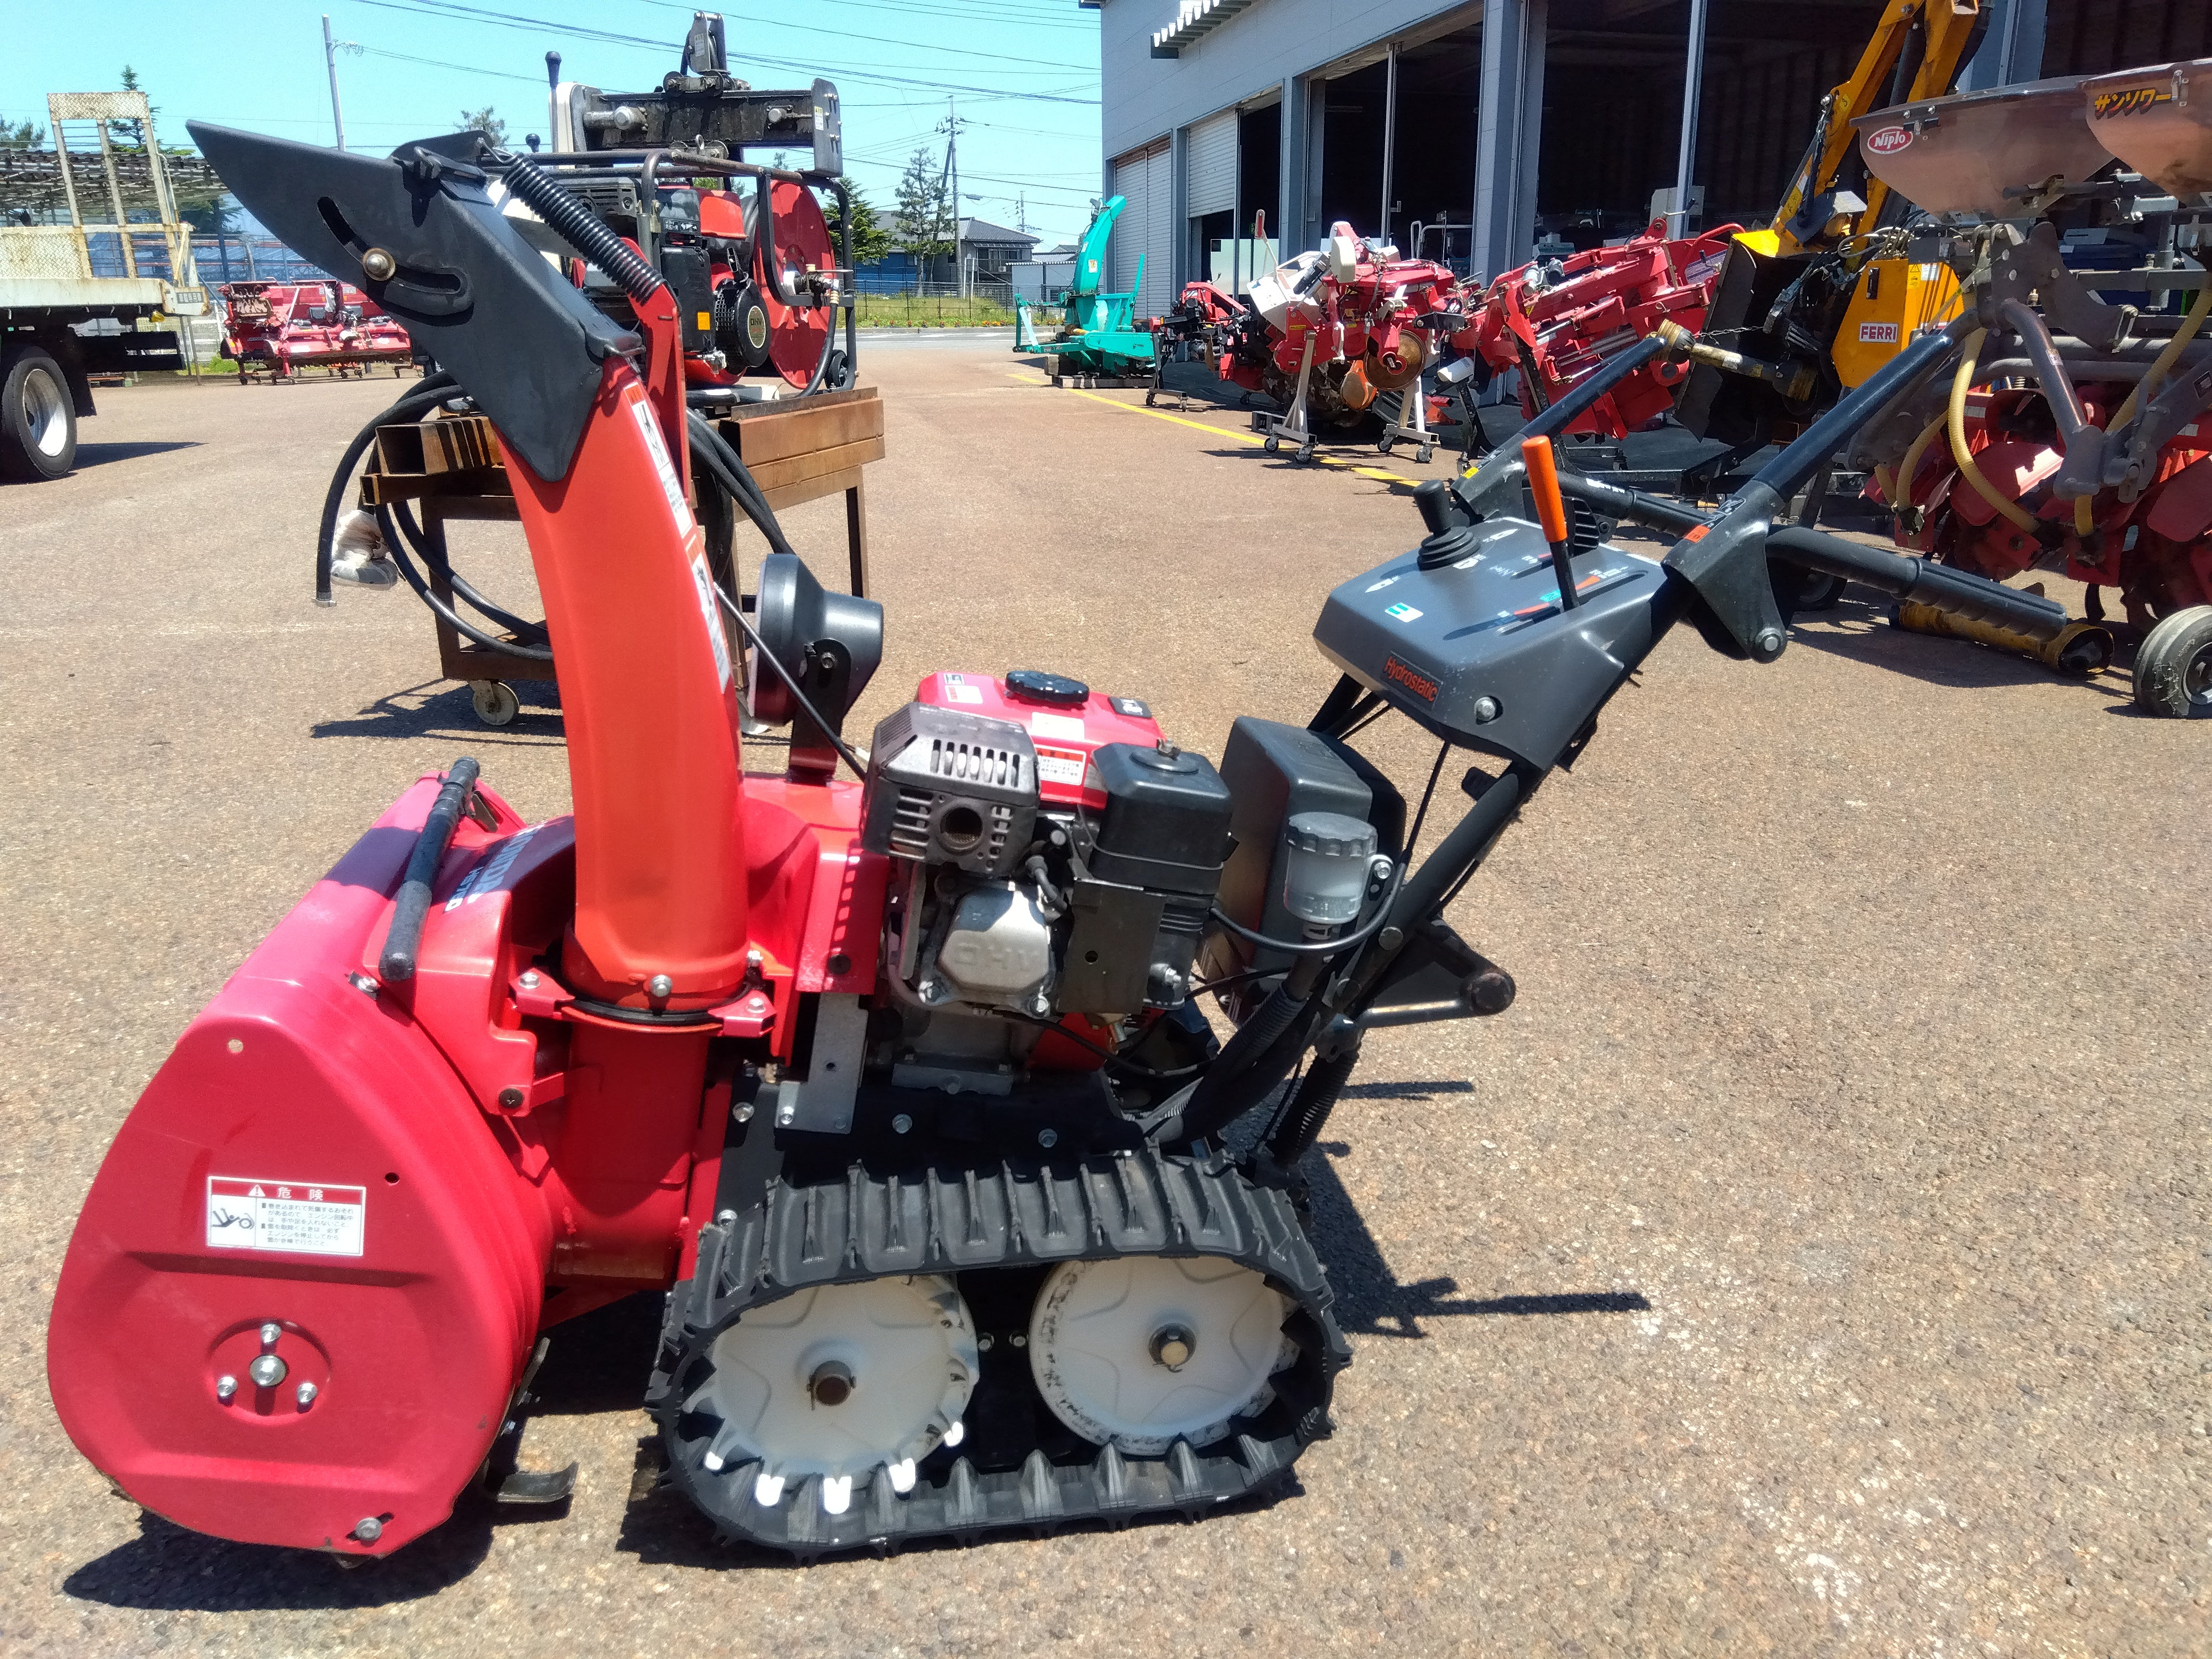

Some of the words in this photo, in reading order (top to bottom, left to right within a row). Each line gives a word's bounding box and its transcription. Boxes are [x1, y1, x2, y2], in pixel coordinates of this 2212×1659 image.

[2094, 89, 2172, 118] サンソワー
[1874, 131, 1906, 149] Niplo
[1861, 325, 1897, 340] FERRI
[1384, 656, 1438, 702] Hydrostatic
[277, 1186, 323, 1201] 危険
